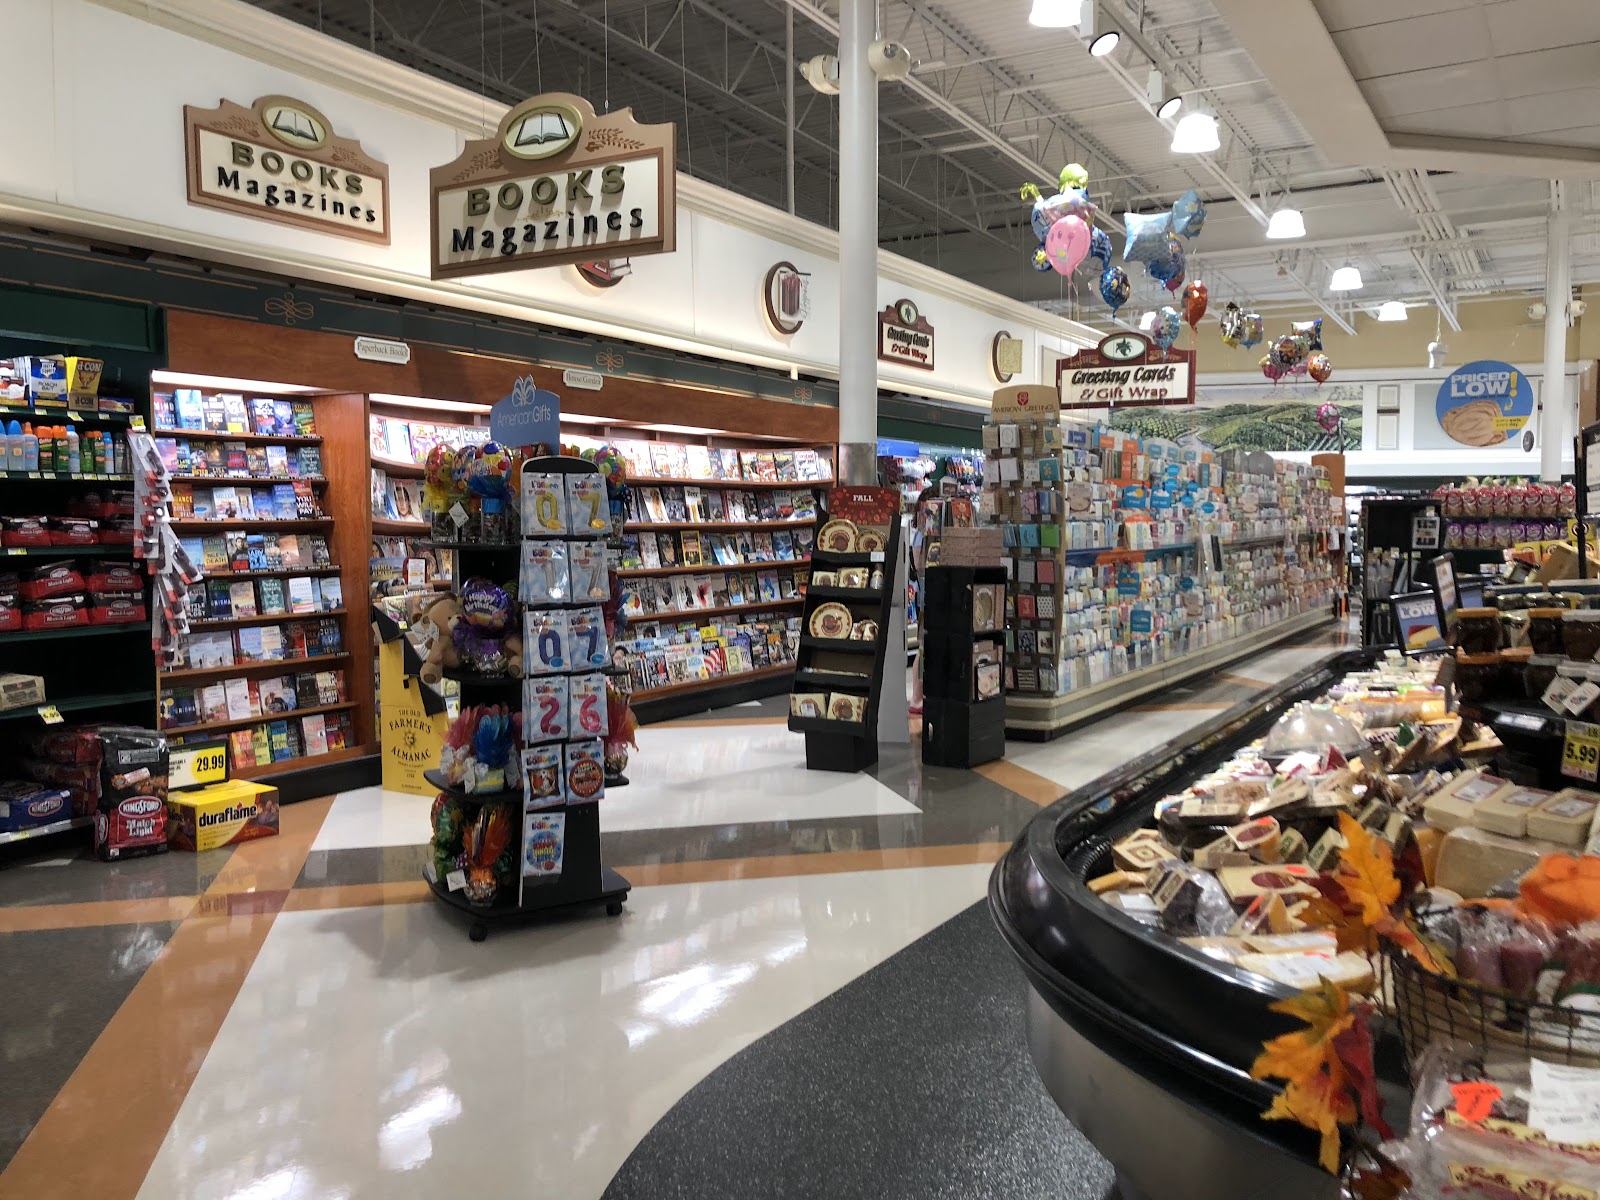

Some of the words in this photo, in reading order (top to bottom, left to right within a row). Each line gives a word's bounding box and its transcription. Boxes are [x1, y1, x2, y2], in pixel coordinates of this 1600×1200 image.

[231, 141, 363, 195] BOOKS
[217, 166, 376, 222] Magazines
[467, 165, 625, 216] BOOKS
[452, 208, 643, 255] Magazines
[357, 342, 388, 355] Paperback
[1071, 368, 1131, 385] Greeting
[1133, 365, 1176, 382] Cards
[1451, 371, 1510, 384] PRICED
[1096, 387, 1123, 399] Gift
[1129, 386, 1168, 400] Wrap
[994, 405, 1022, 413] AMERICAN
[853, 494, 874, 502] FALL
[468, 591, 496, 604] Happy
[464, 601, 499, 613] Birthday
[1398, 604, 1436, 620] LOW
[389, 717, 432, 734] FARMER'S
[391, 745, 432, 762] ALMANAC
[1566, 742, 1597, 764] 5.99
[196, 754, 225, 773] 29.99
[31, 798, 61, 812] KINGSFORD
[122, 799, 159, 814] KINGSFORD
[126, 818, 156, 829] Match
[199, 804, 257, 828] duraflame
[129, 826, 153, 837] Light
